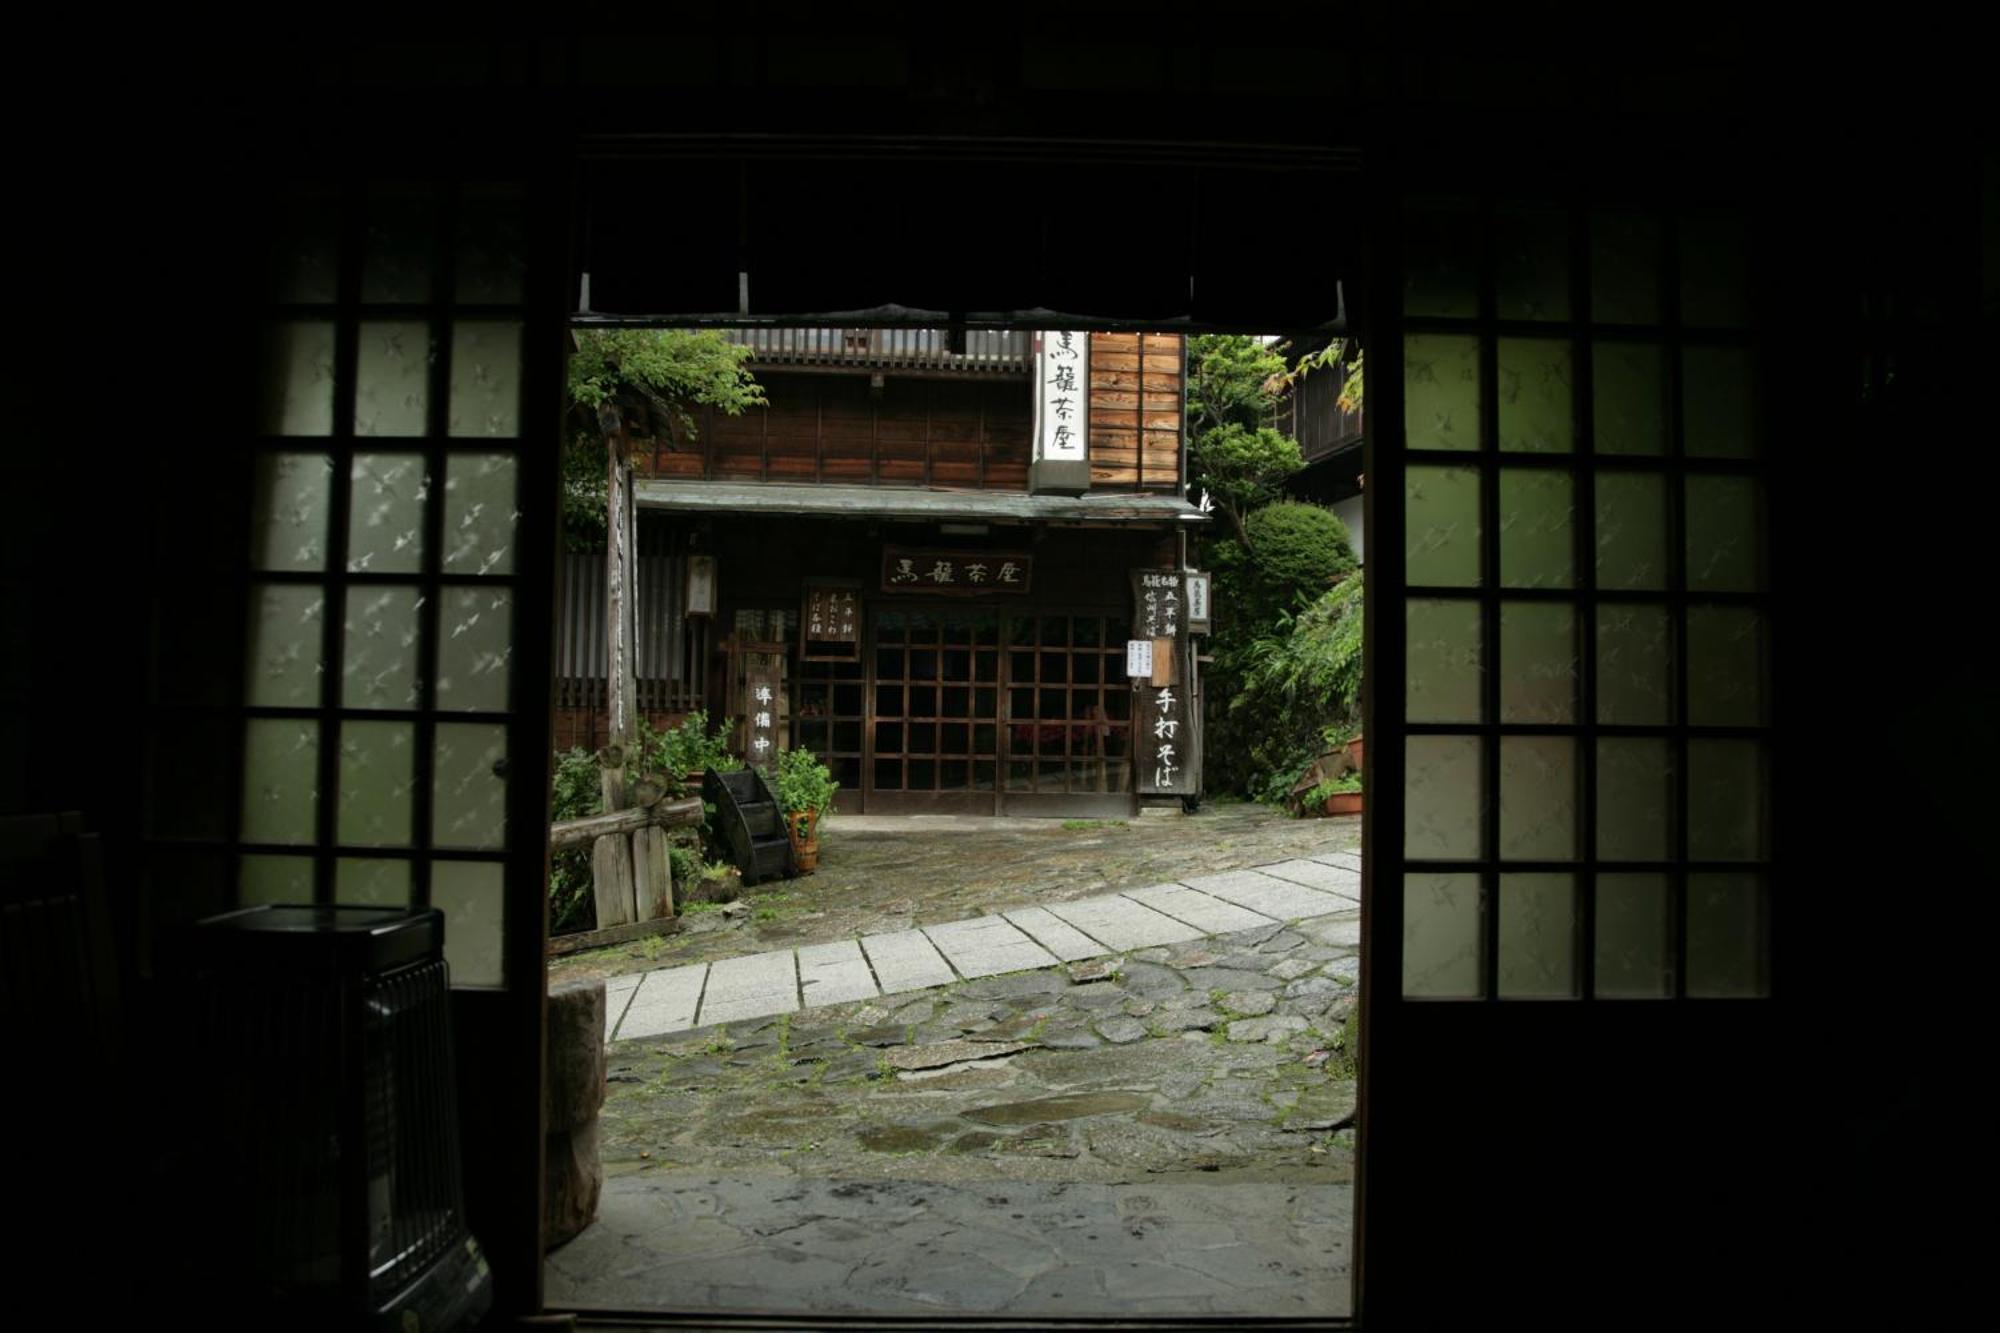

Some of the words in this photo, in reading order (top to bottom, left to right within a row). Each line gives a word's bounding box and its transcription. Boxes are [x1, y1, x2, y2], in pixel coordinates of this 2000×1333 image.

[754, 685, 772, 752] 準備中
[1152, 687, 1180, 787] 手打そば
